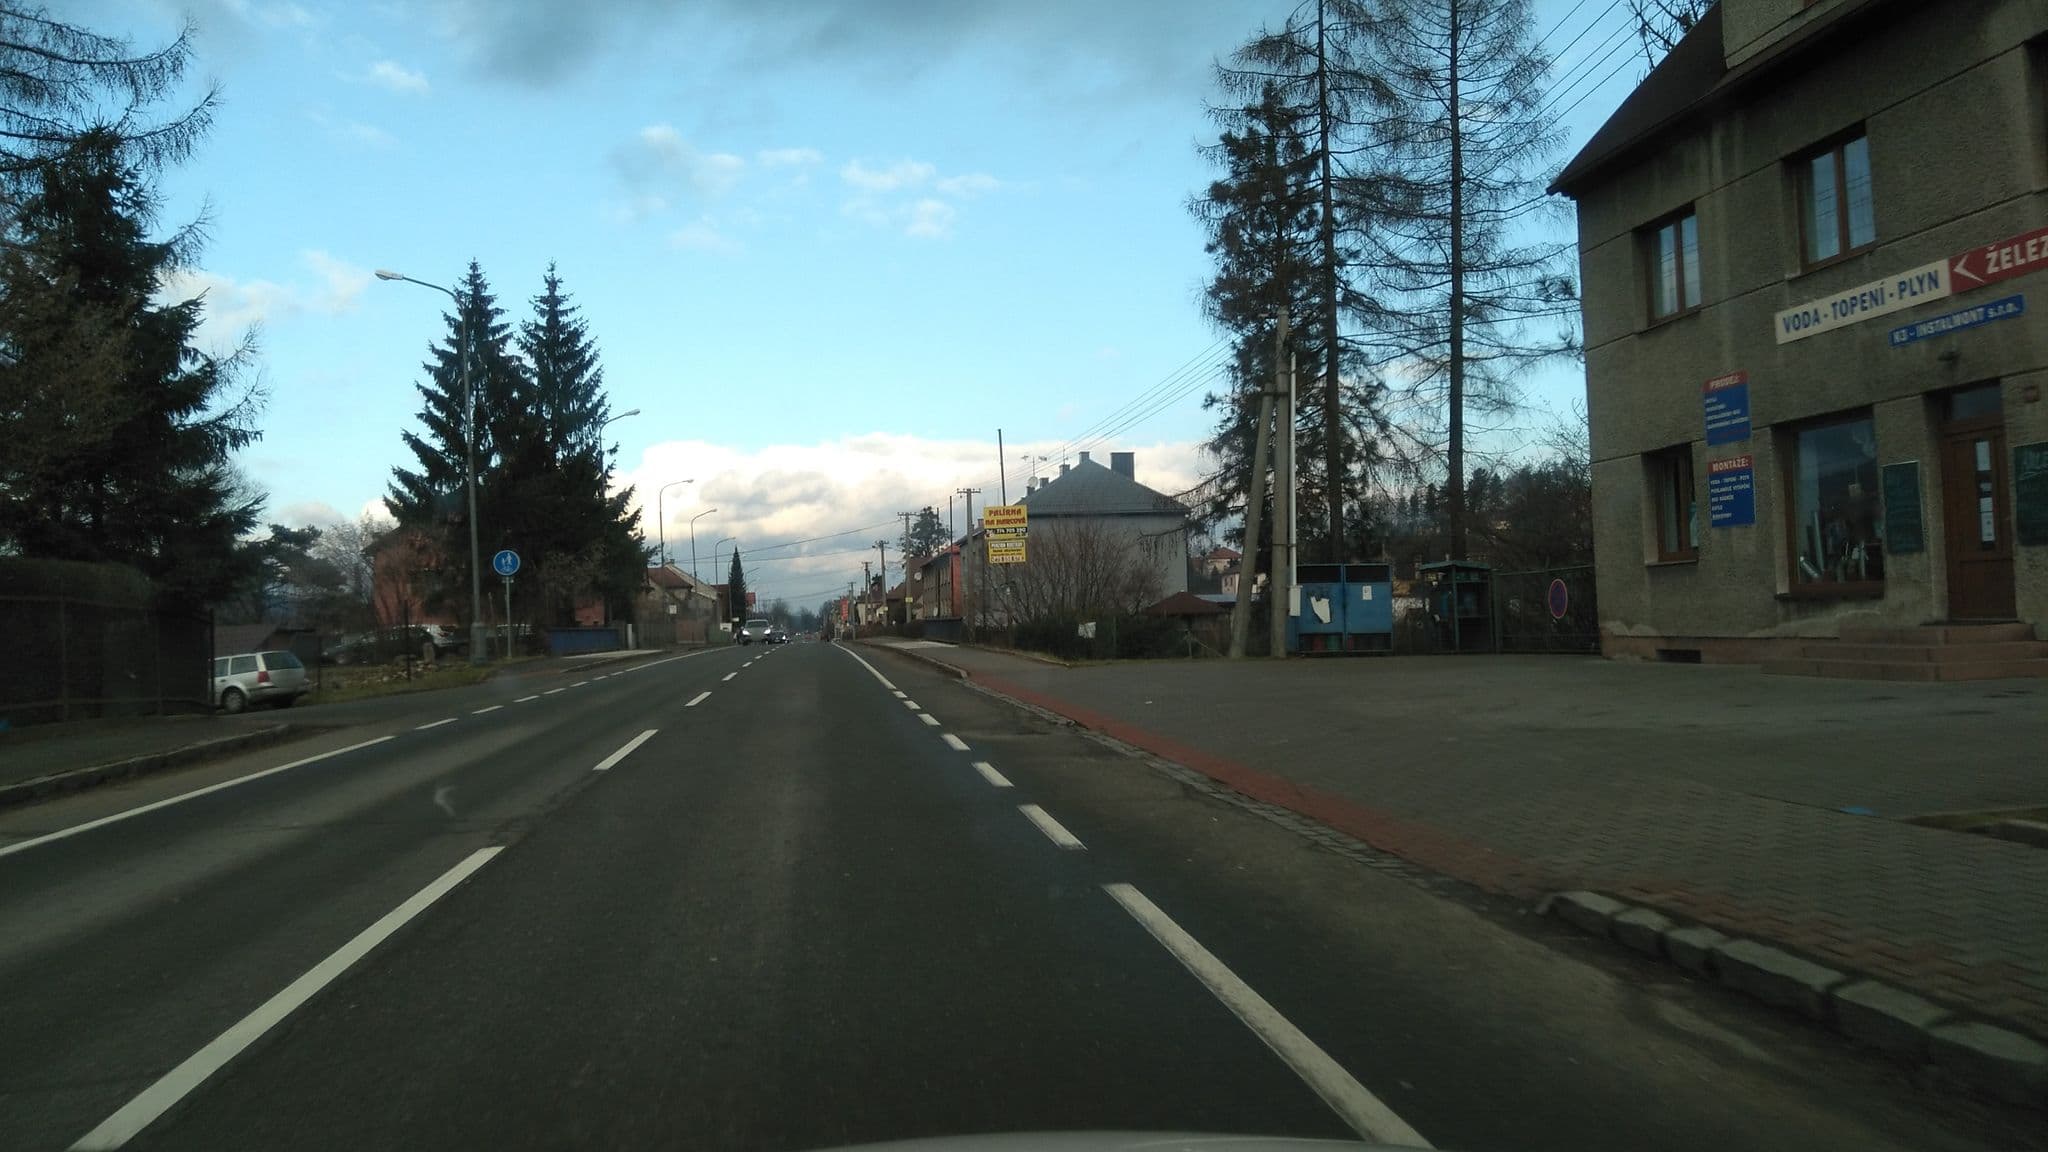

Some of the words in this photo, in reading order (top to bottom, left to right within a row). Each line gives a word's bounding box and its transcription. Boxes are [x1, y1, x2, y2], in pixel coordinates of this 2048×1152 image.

[1783, 308, 1820, 333] VODA
[1831, 281, 1886, 320] TOPENÍ
[1898, 269, 1940, 300] PLYN
